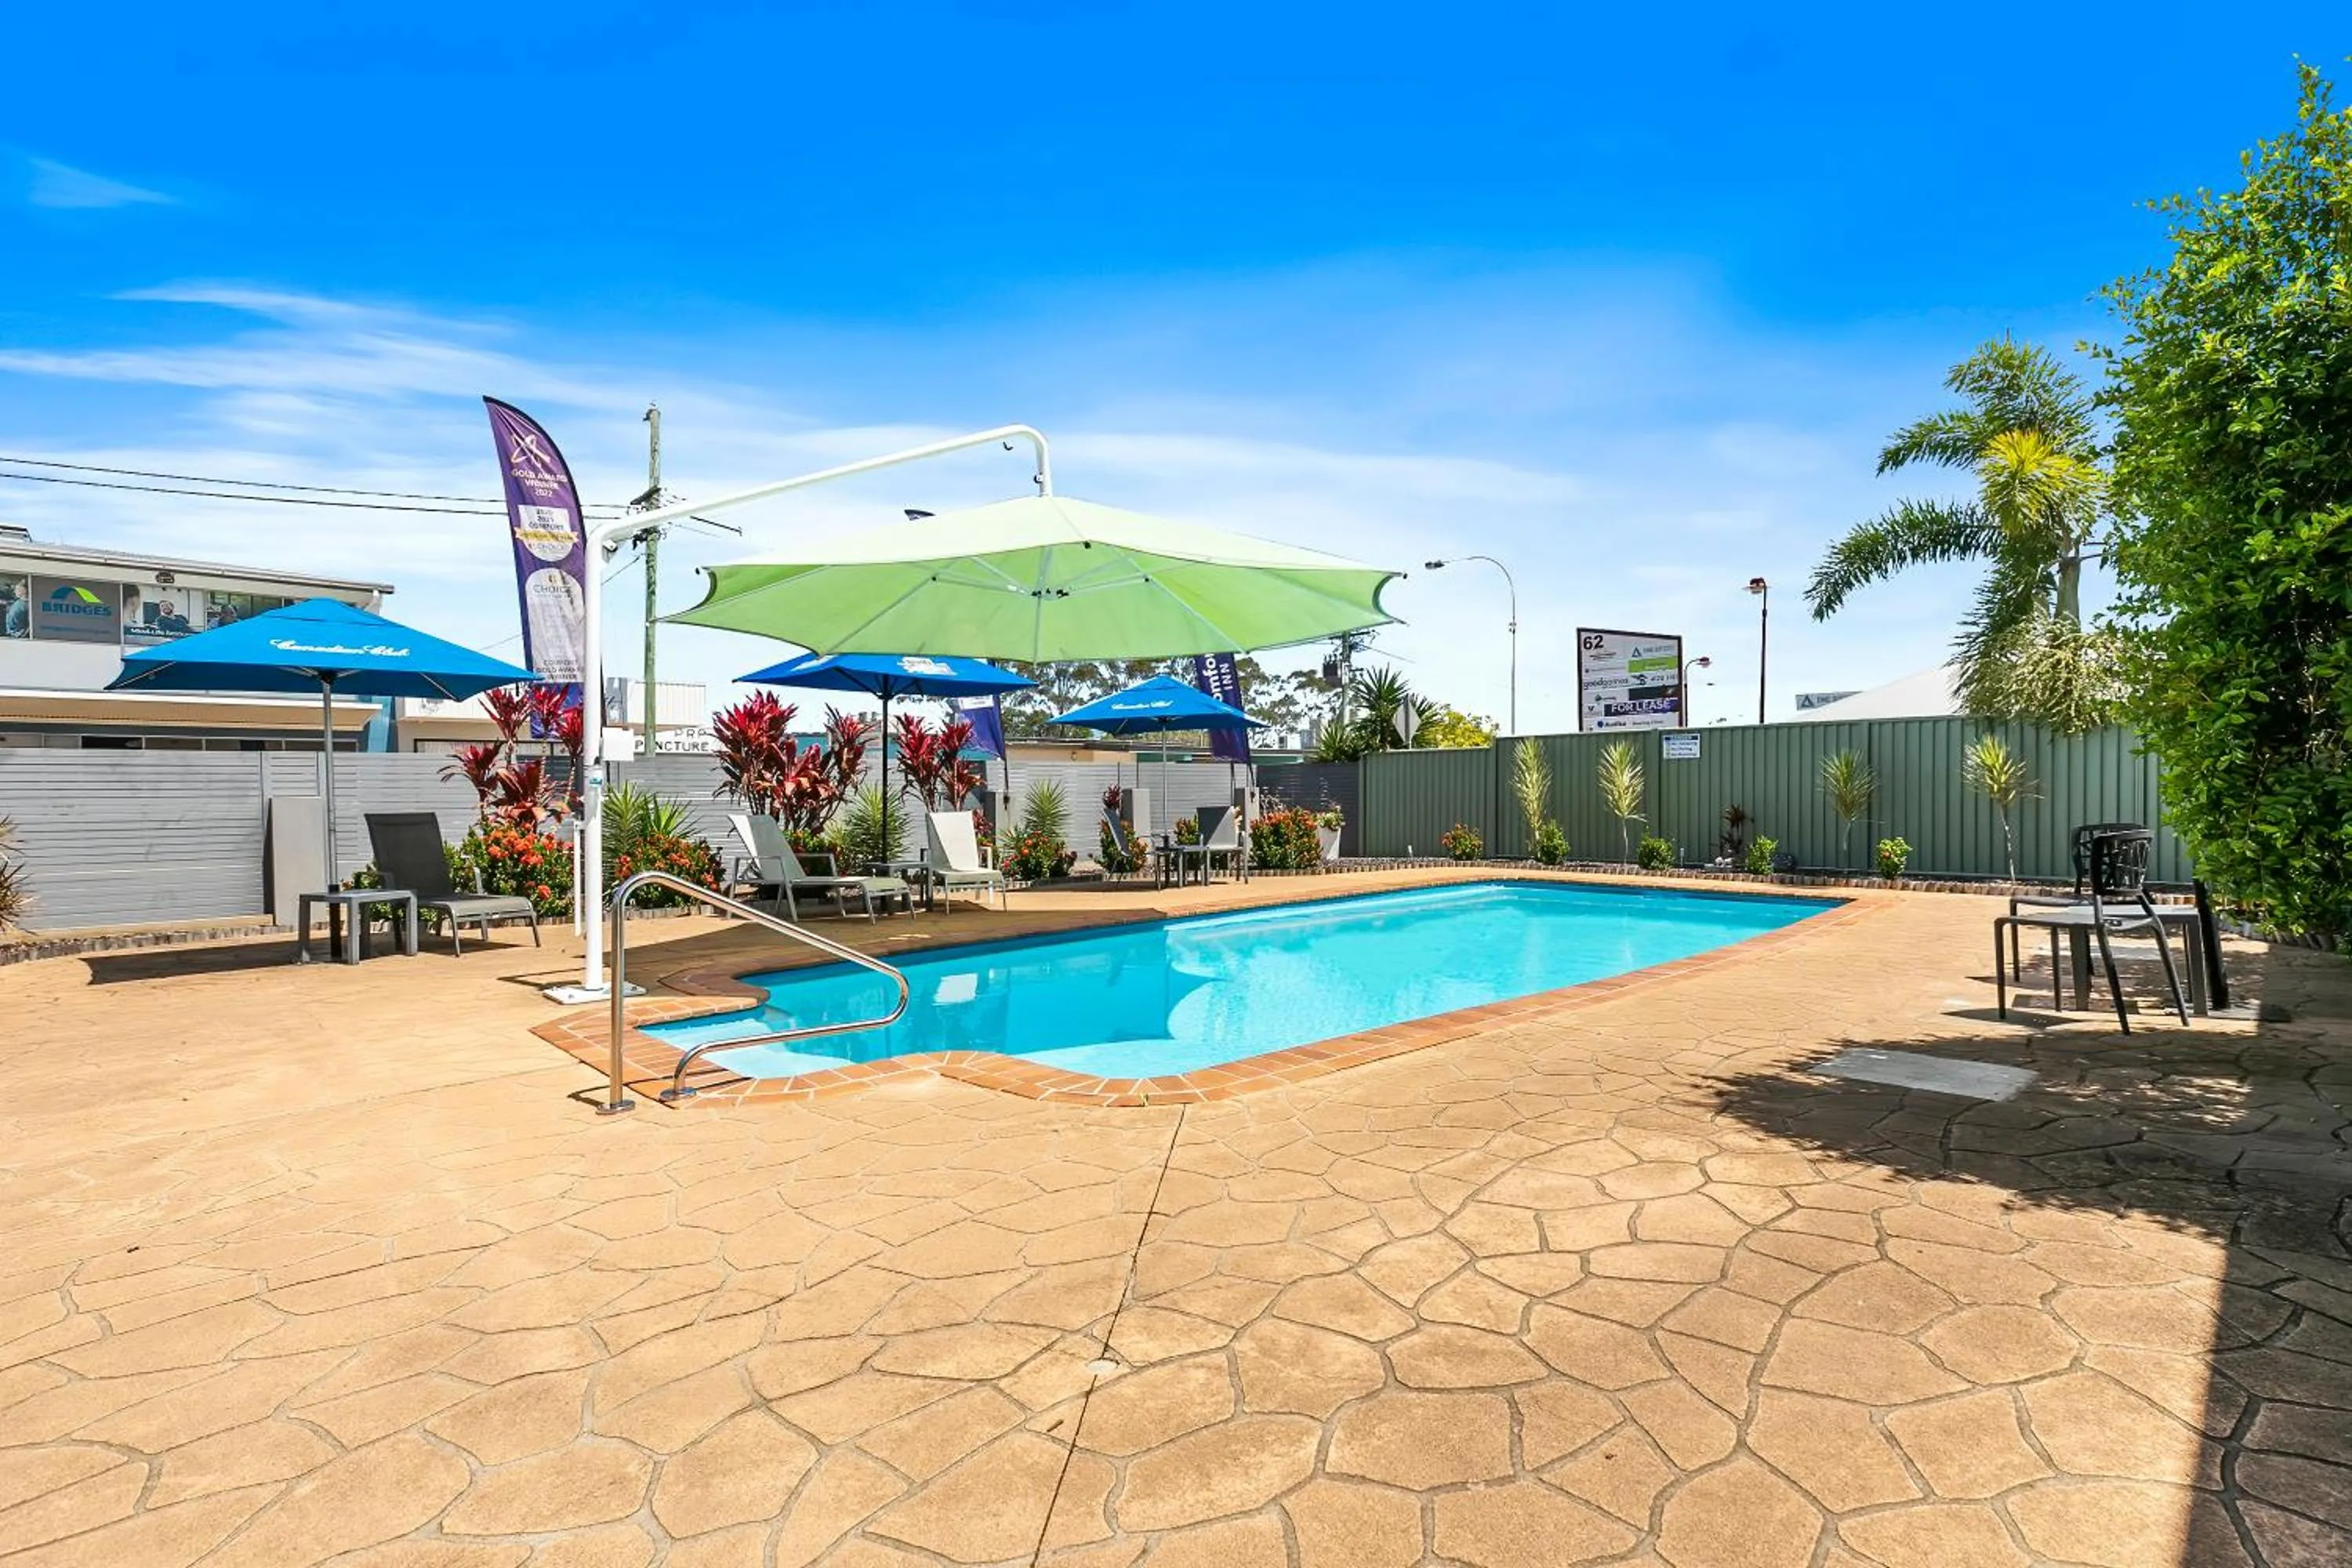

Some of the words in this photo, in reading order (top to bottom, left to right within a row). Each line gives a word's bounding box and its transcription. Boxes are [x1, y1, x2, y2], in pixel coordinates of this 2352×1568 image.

[512, 469, 535, 478] GOLD
[537, 472, 568, 482] AWARD
[524, 478, 559, 490] WINNER
[533, 584, 572, 594] CHOICE
[42, 601, 112, 618] BRIDGES
[1583, 634, 1604, 650] 62
[1219, 662, 1233, 690] INN
[1610, 702, 1634, 713] FOR
[1636, 697, 1671, 711] LEASE
[634, 739, 710, 753] PNCTURE
